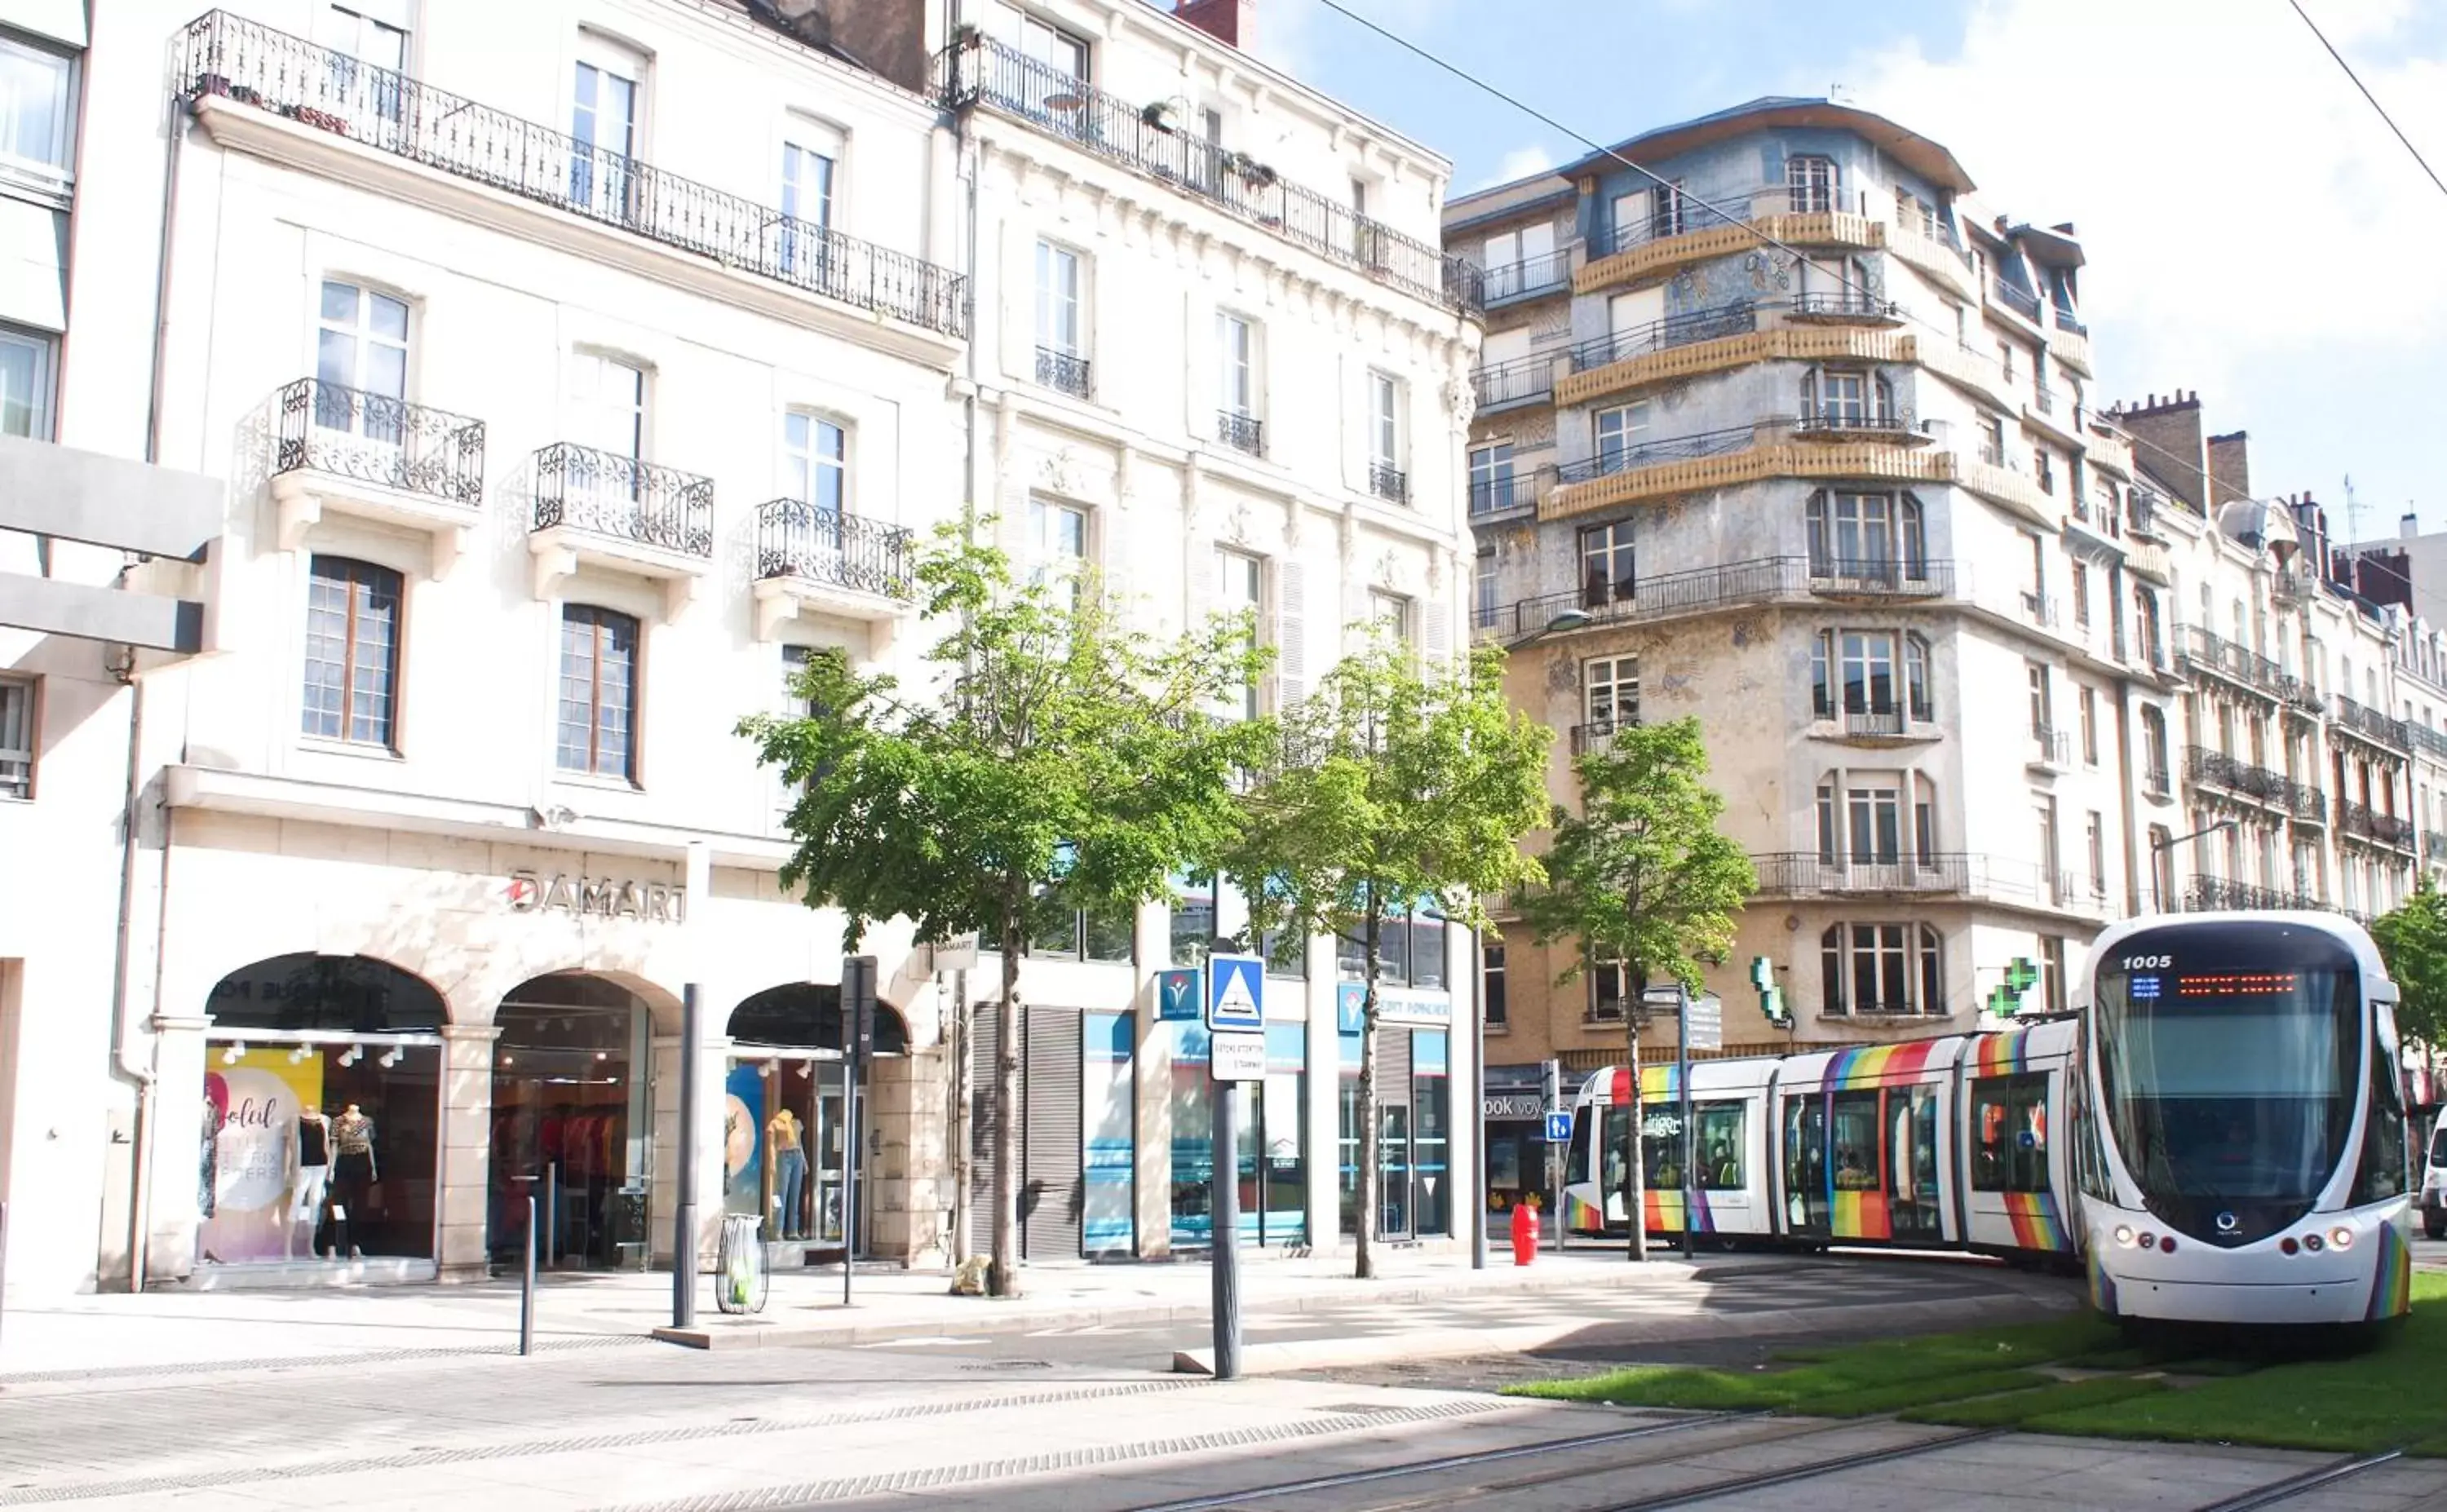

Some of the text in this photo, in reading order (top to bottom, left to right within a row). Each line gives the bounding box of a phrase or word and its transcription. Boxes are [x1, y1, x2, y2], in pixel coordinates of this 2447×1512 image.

[507, 869, 687, 922] DAMART
[2122, 955, 2172, 970] 1005
[1485, 1095, 1513, 1115] ook
